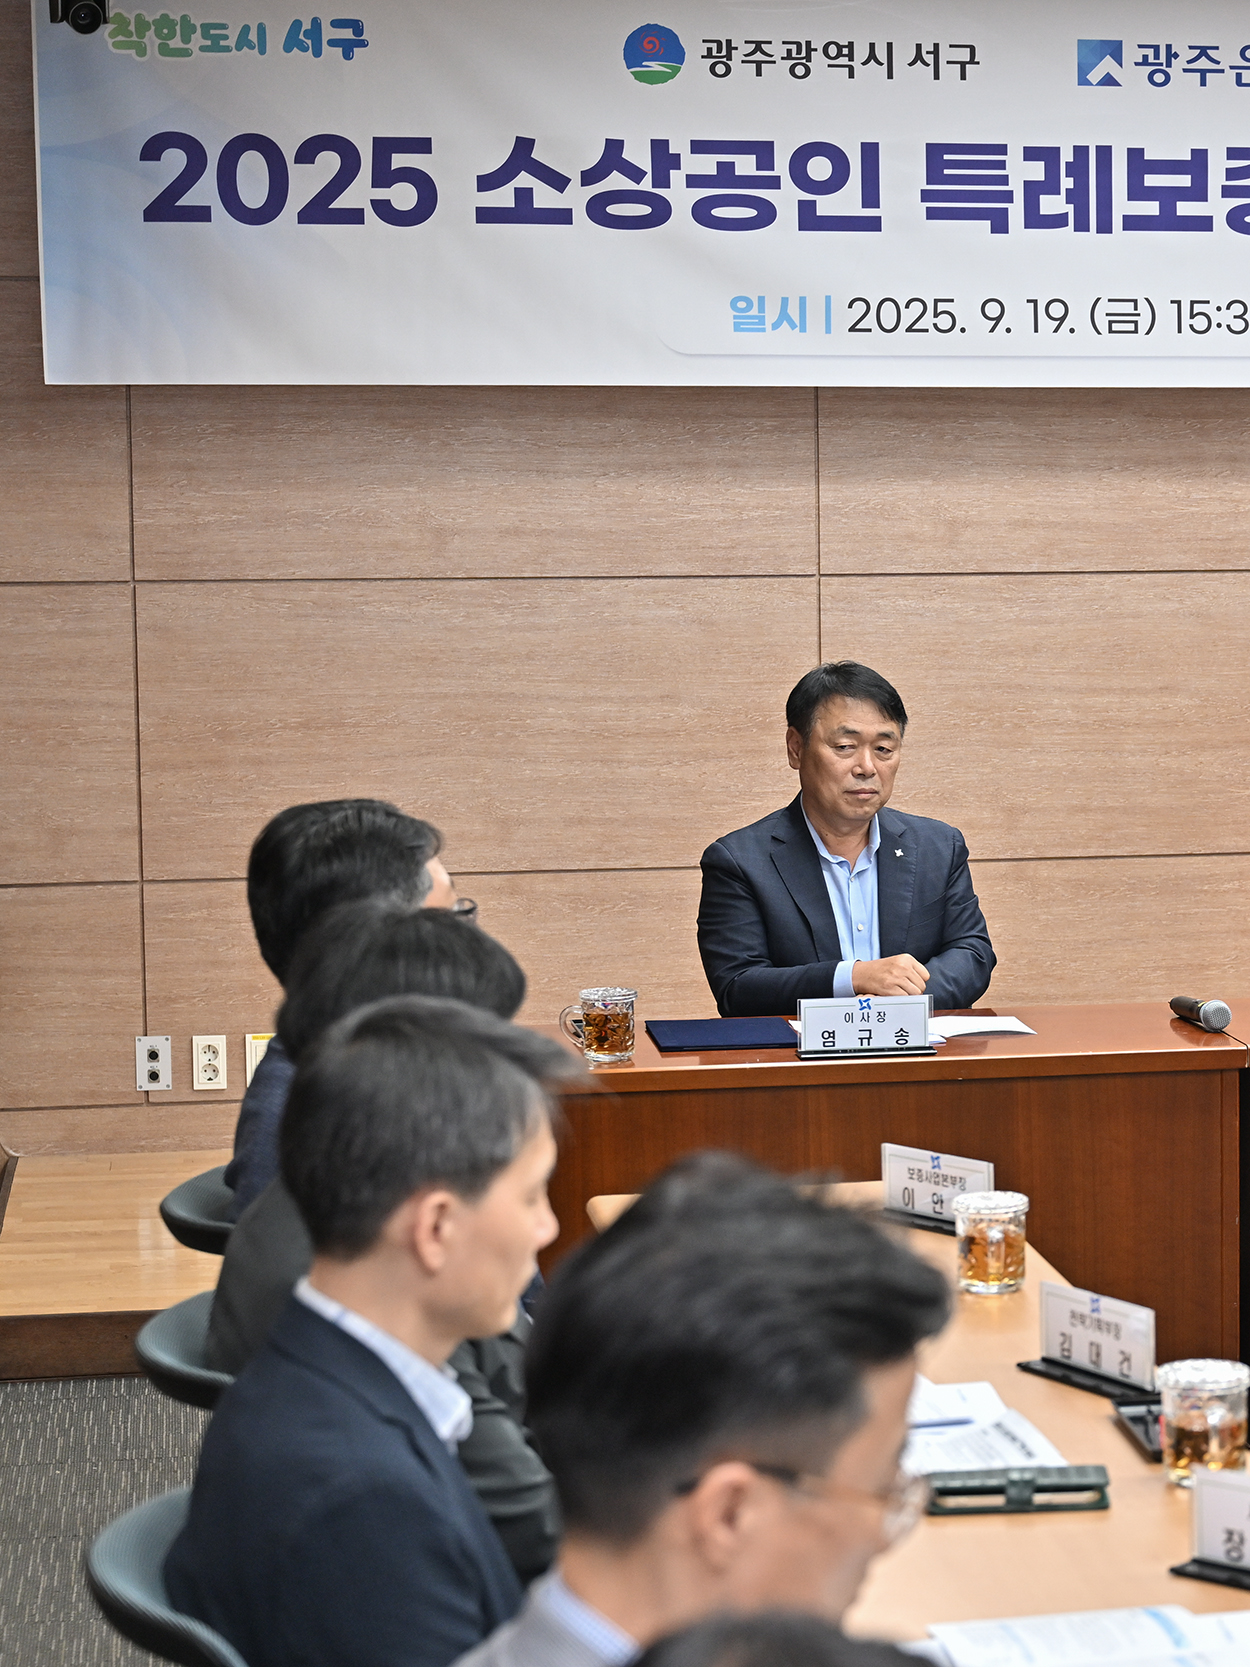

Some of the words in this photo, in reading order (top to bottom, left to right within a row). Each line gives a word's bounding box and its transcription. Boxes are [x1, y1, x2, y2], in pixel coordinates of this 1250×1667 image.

[108, 12, 267, 58] 착한도시
[283, 16, 369, 61] 서구
[700, 38, 895, 80] 광주광역시
[906, 42, 980, 81] 서구
[138, 130, 438, 228] 2025
[475, 135, 883, 232] 소상공인
[729, 295, 807, 334] 일시
[846, 296, 967, 335] 2025.
[979, 297, 1012, 335] 9.
[1026, 298, 1076, 335] 19.
[1089, 296, 1157, 336] (금)
[844, 1011, 887, 1024] 이사장
